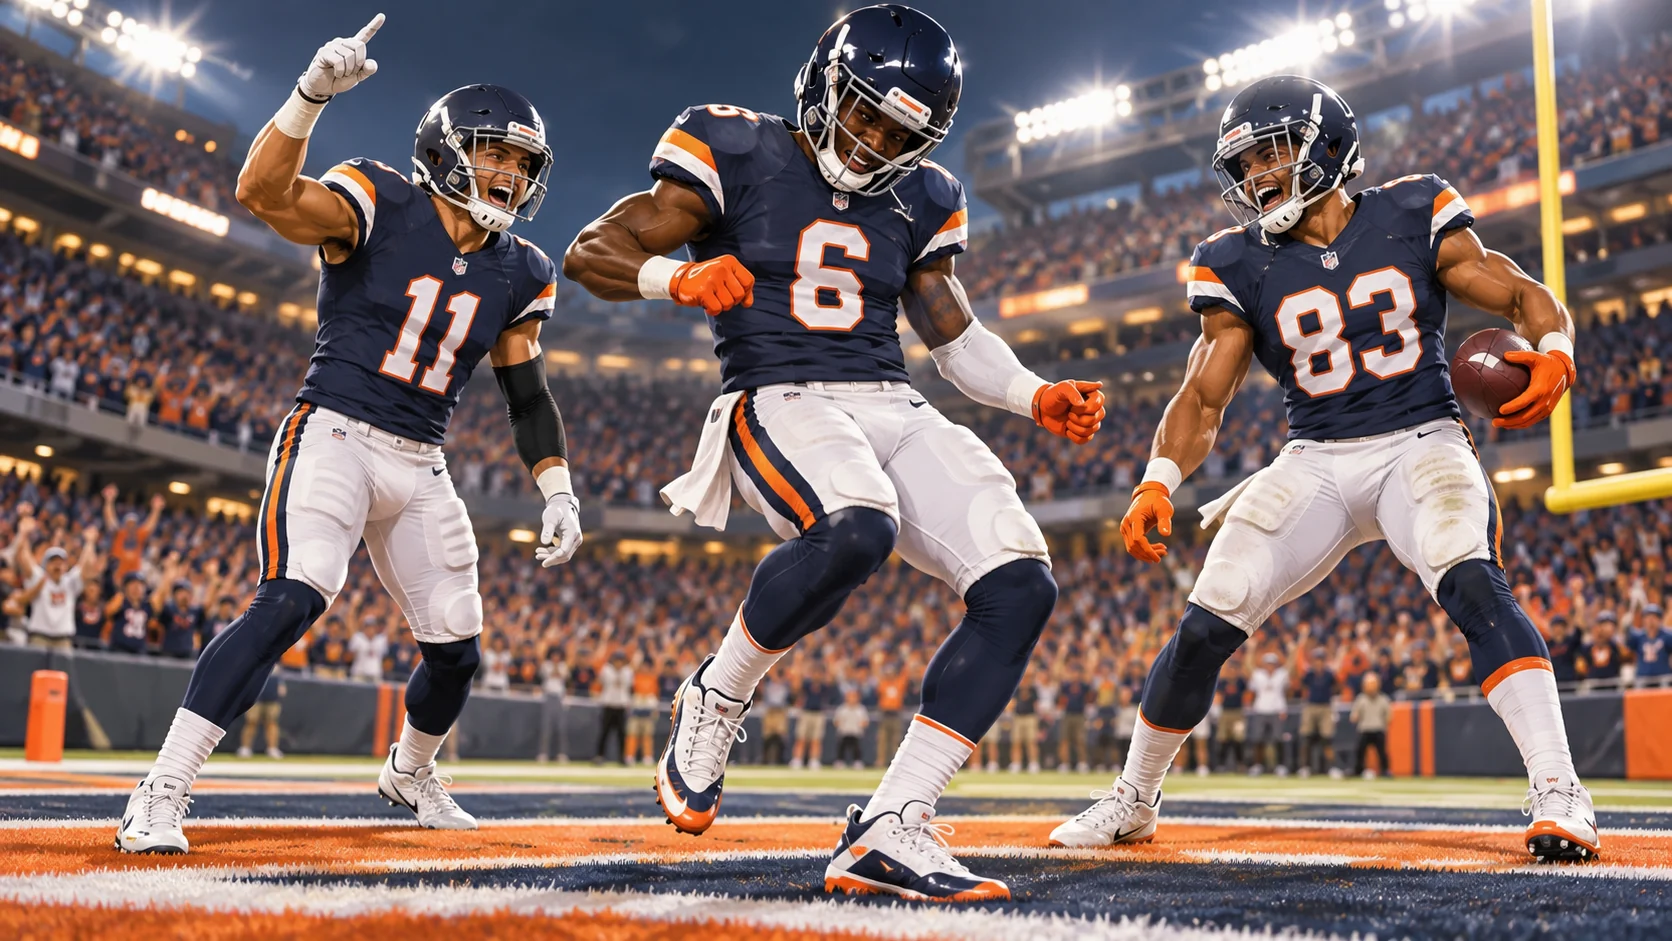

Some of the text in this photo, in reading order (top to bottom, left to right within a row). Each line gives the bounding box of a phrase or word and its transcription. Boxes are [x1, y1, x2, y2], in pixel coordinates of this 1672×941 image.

[379, 273, 481, 396] 11
[790, 218, 871, 332] 6
[1274, 265, 1424, 398] 83
